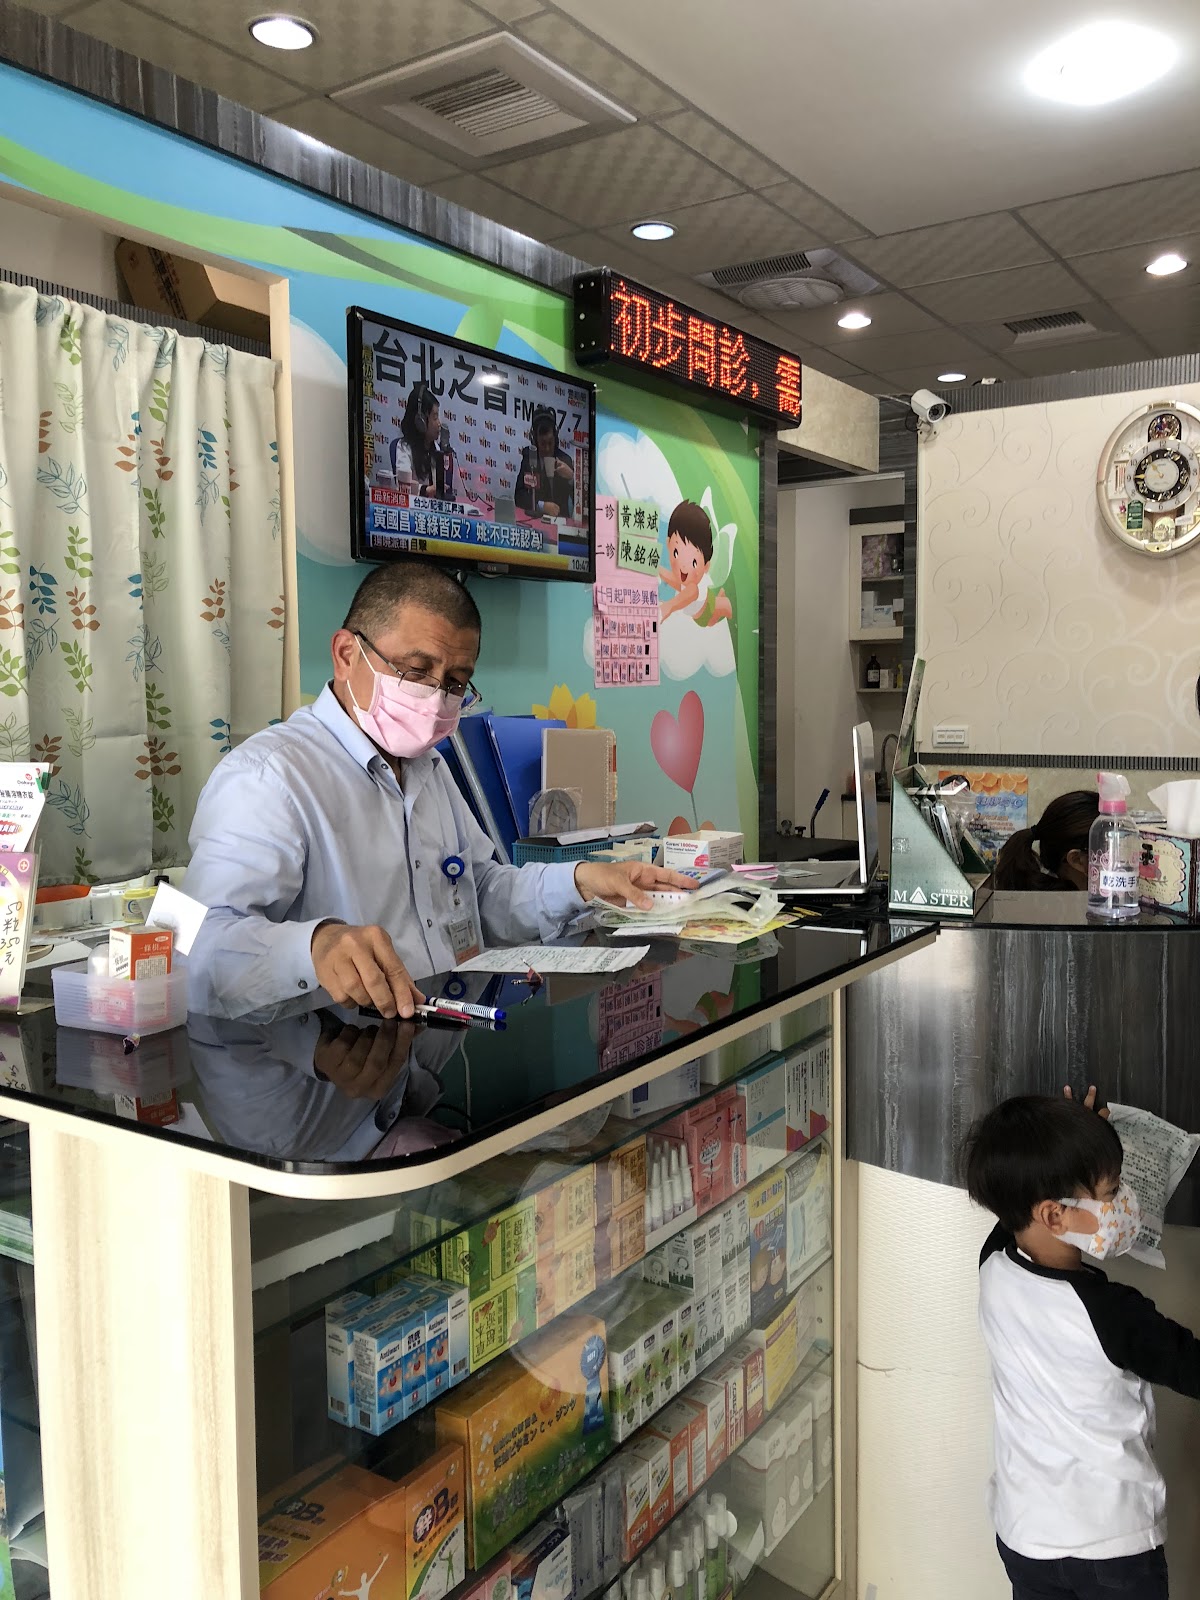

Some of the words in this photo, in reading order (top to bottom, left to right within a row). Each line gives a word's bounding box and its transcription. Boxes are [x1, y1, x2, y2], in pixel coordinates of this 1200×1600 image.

[373, 329, 510, 416] 台北之音
[374, 490, 407, 506] 最新消息
[374, 506, 411, 533] 黃國昌
[620, 539, 660, 569] 陳銘倫
[1103, 875, 1136, 887] 乾洗手
[6, 901, 22, 915] 50
[3, 919, 19, 935] 粒
[5, 952, 15, 965] 元
